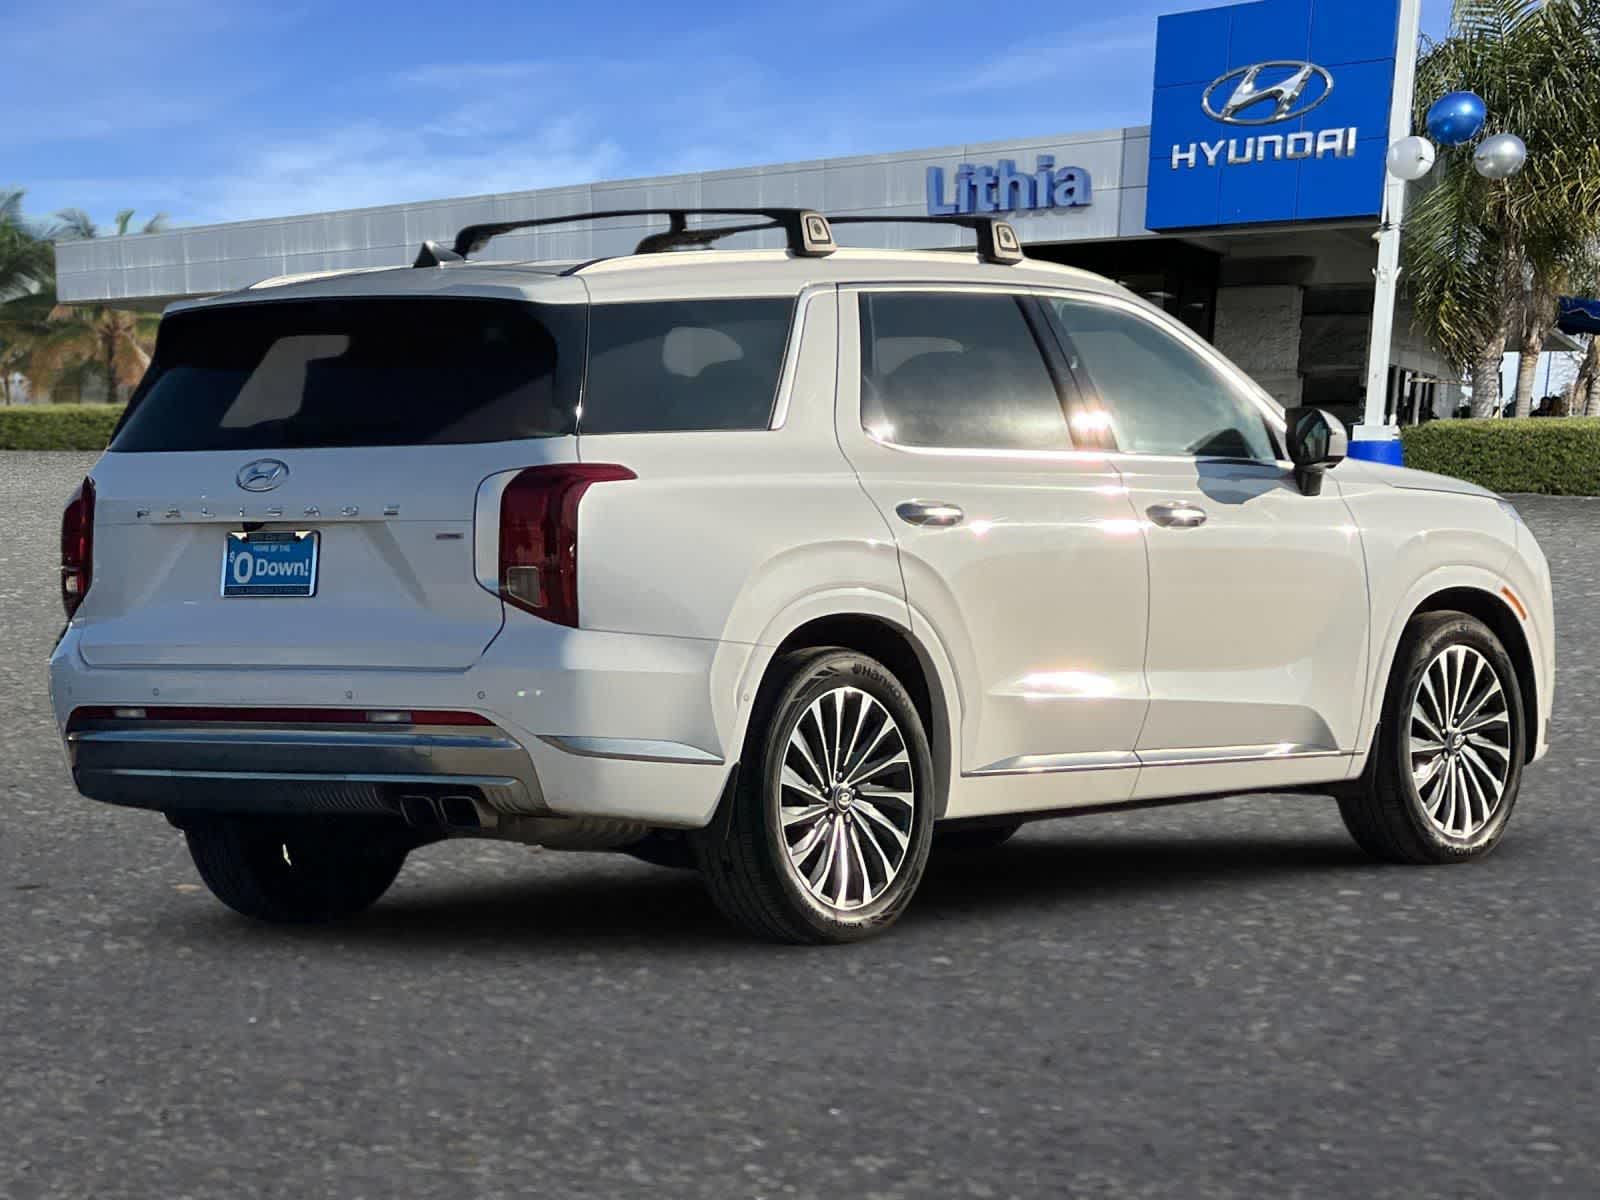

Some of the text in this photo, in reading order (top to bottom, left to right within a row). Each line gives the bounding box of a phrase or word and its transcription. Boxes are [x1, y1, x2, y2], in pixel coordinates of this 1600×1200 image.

[1171, 127, 1357, 169] HYUNDAI
[926, 155, 1092, 215] Lithia
[136, 504, 401, 520] PALISADE
[256, 558, 310, 576] Down!
